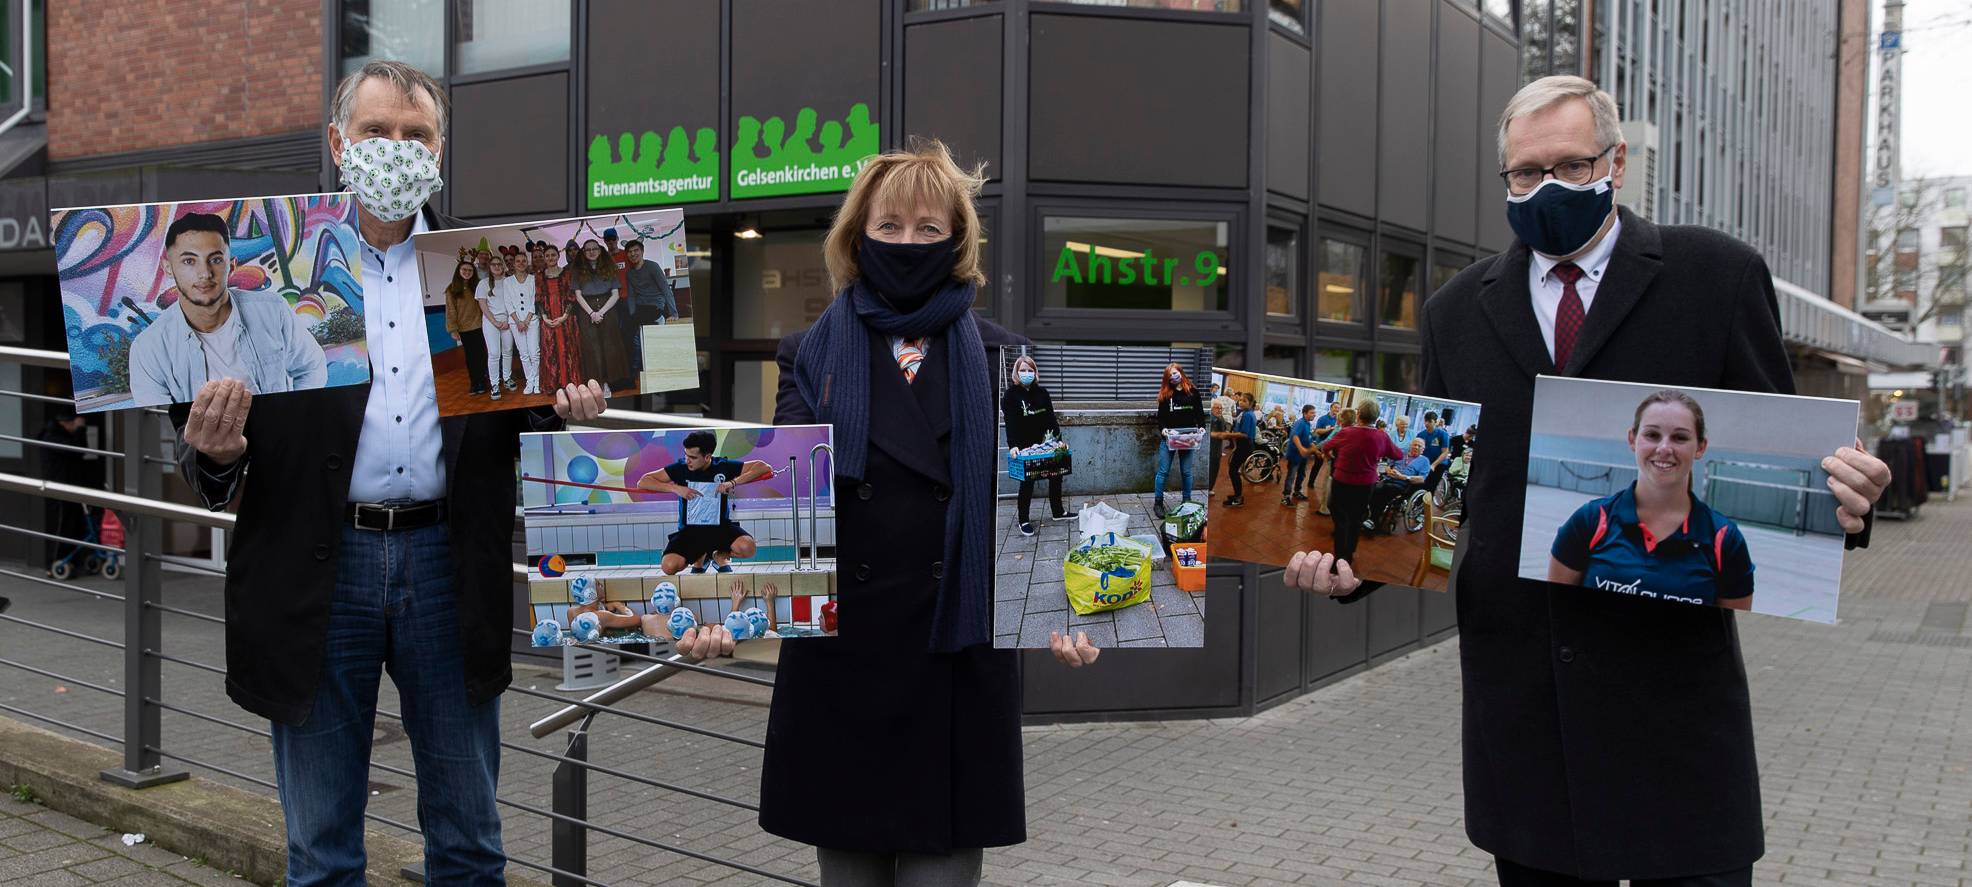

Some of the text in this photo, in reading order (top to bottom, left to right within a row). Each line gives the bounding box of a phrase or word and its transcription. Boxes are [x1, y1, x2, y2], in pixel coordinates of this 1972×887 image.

[1876, 52, 1895, 188] PARKHAUS
[593, 174, 713, 198] Ehrenamtsagentur
[737, 161, 838, 186] Gelsenkirchen
